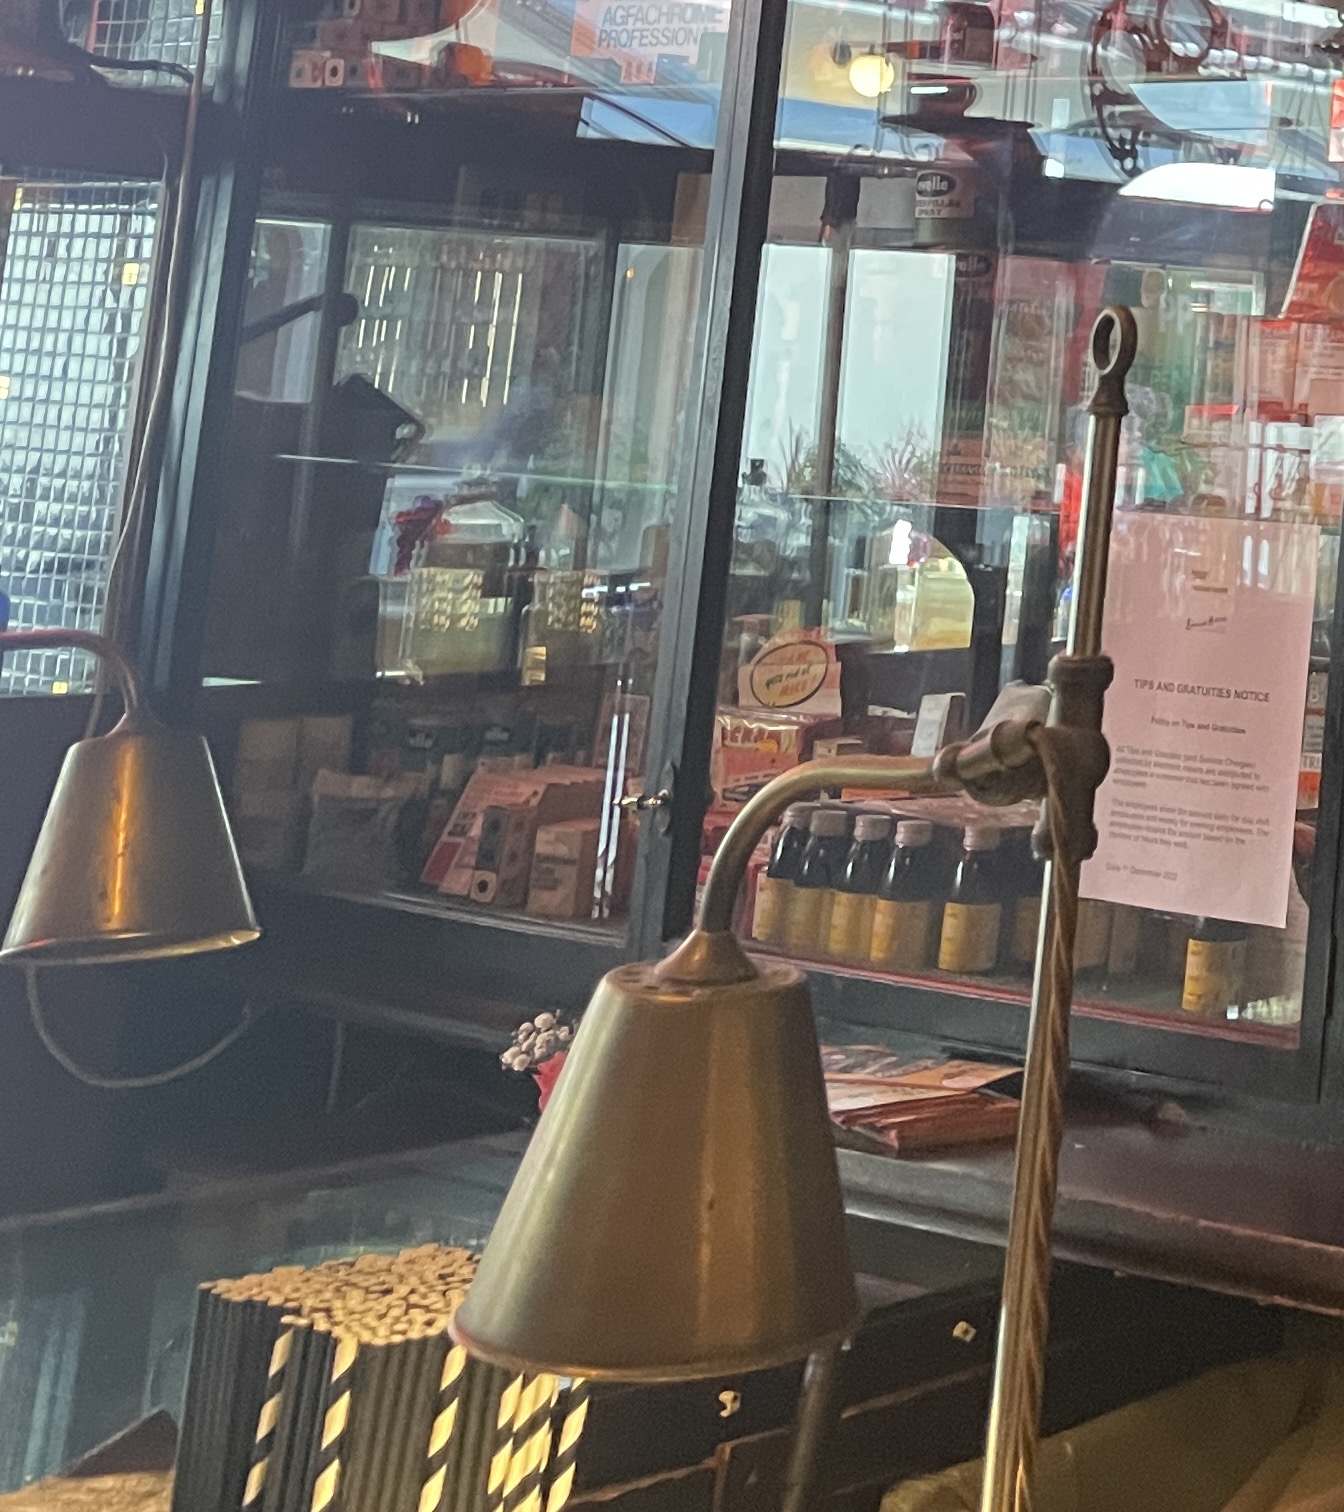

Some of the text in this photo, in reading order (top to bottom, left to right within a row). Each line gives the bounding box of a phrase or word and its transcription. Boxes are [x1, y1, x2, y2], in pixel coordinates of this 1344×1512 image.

[602, 3, 722, 28] AGFACHROME
[1135, 679, 1270, 703] TIPS AND GRATUITIES NOTICE
